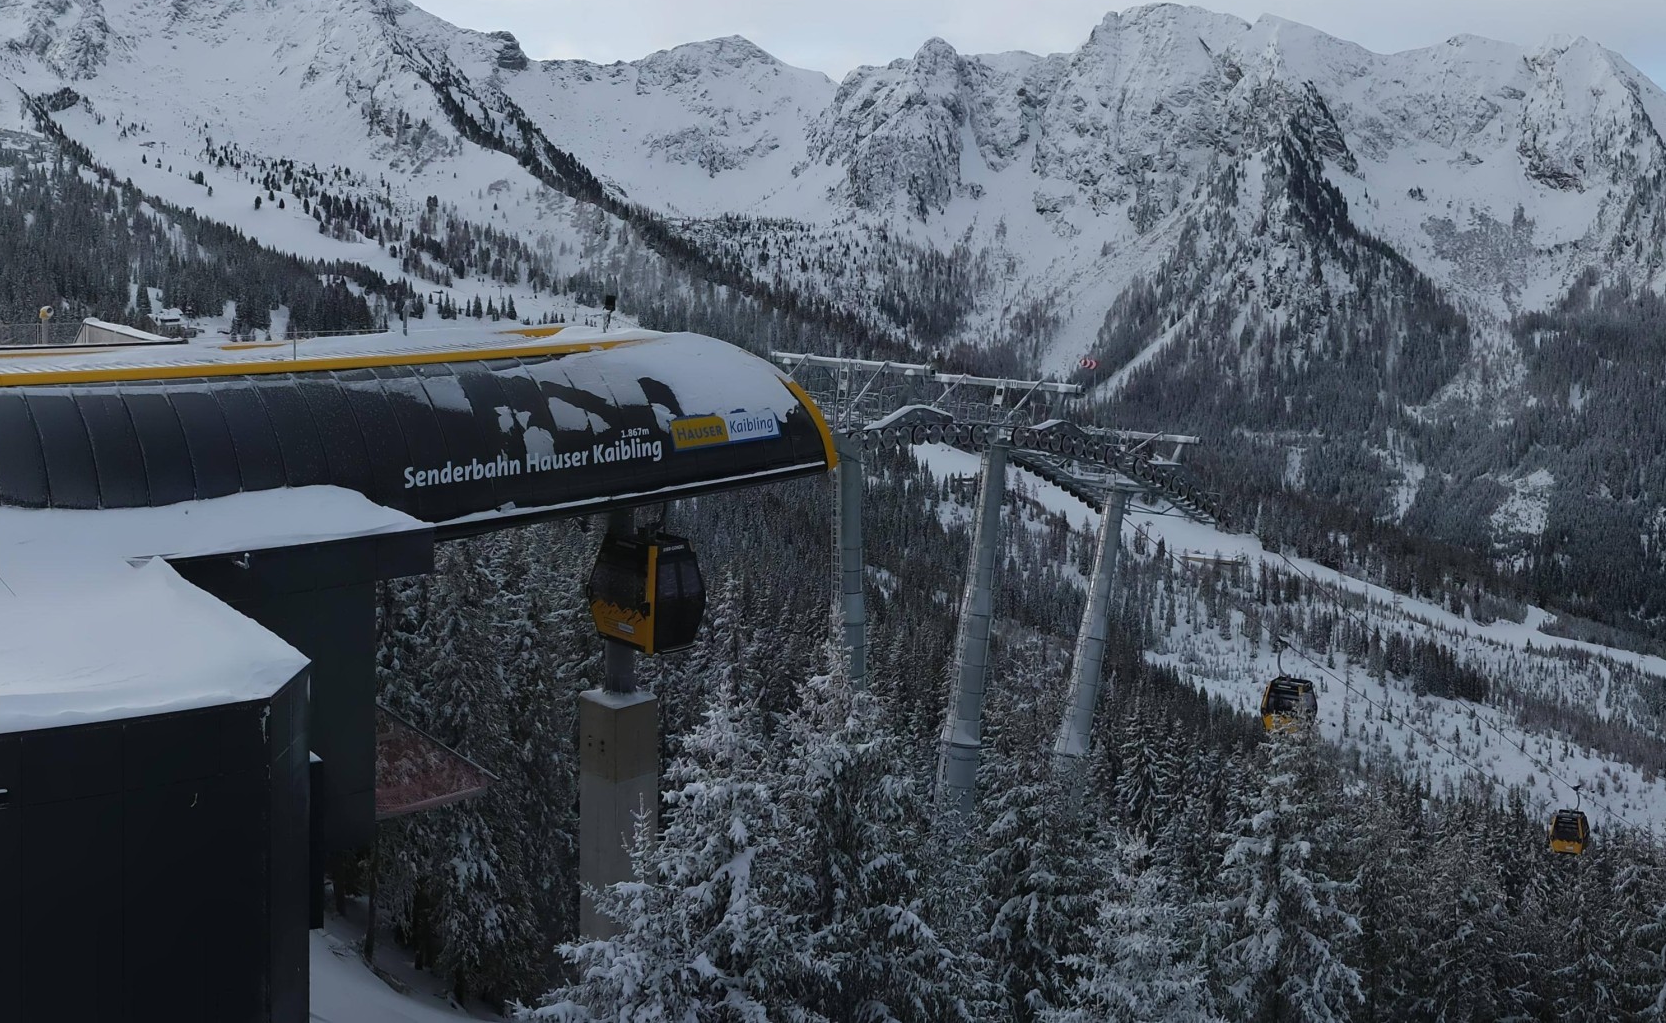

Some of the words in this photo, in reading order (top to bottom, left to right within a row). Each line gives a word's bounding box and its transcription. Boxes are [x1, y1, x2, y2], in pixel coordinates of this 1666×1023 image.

[620, 427, 650, 439] 1.867m
[676, 425, 724, 441] HAUSER
[729, 417, 774, 435] Kaibling
[404, 454, 521, 489] Senderbahn
[526, 448, 589, 473] Hauser
[593, 438, 662, 464] Kaibling
